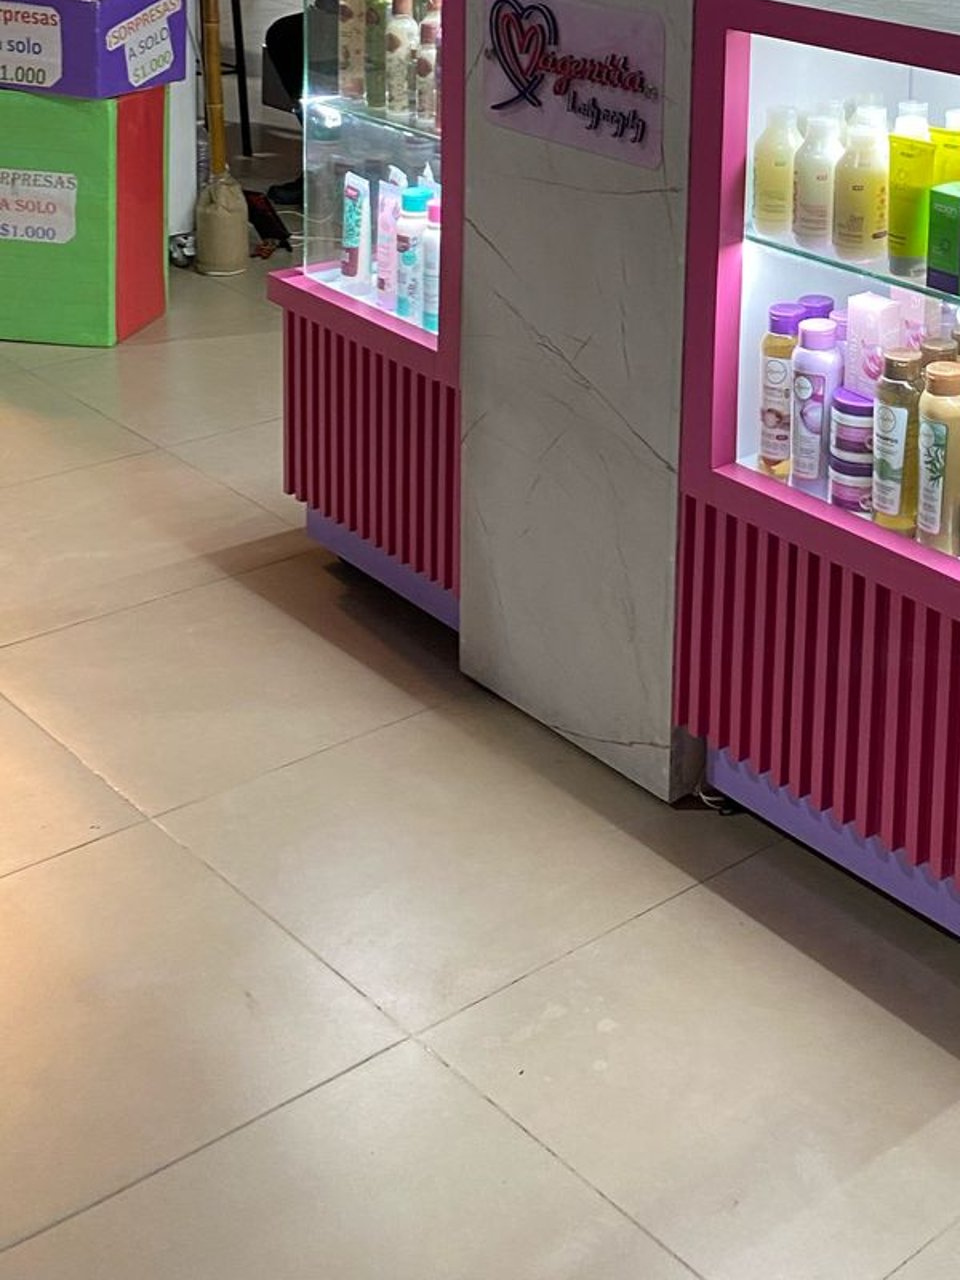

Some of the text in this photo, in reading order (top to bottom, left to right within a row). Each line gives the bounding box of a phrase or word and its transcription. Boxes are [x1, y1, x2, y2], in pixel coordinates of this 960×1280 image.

[7, 37, 42, 55] solo
[128, 26, 169, 61] A SOLO
[132, 50, 171, 84] $1.000
[0, 198, 57, 215] A SOLO
[0, 223, 57, 240] $1.000
